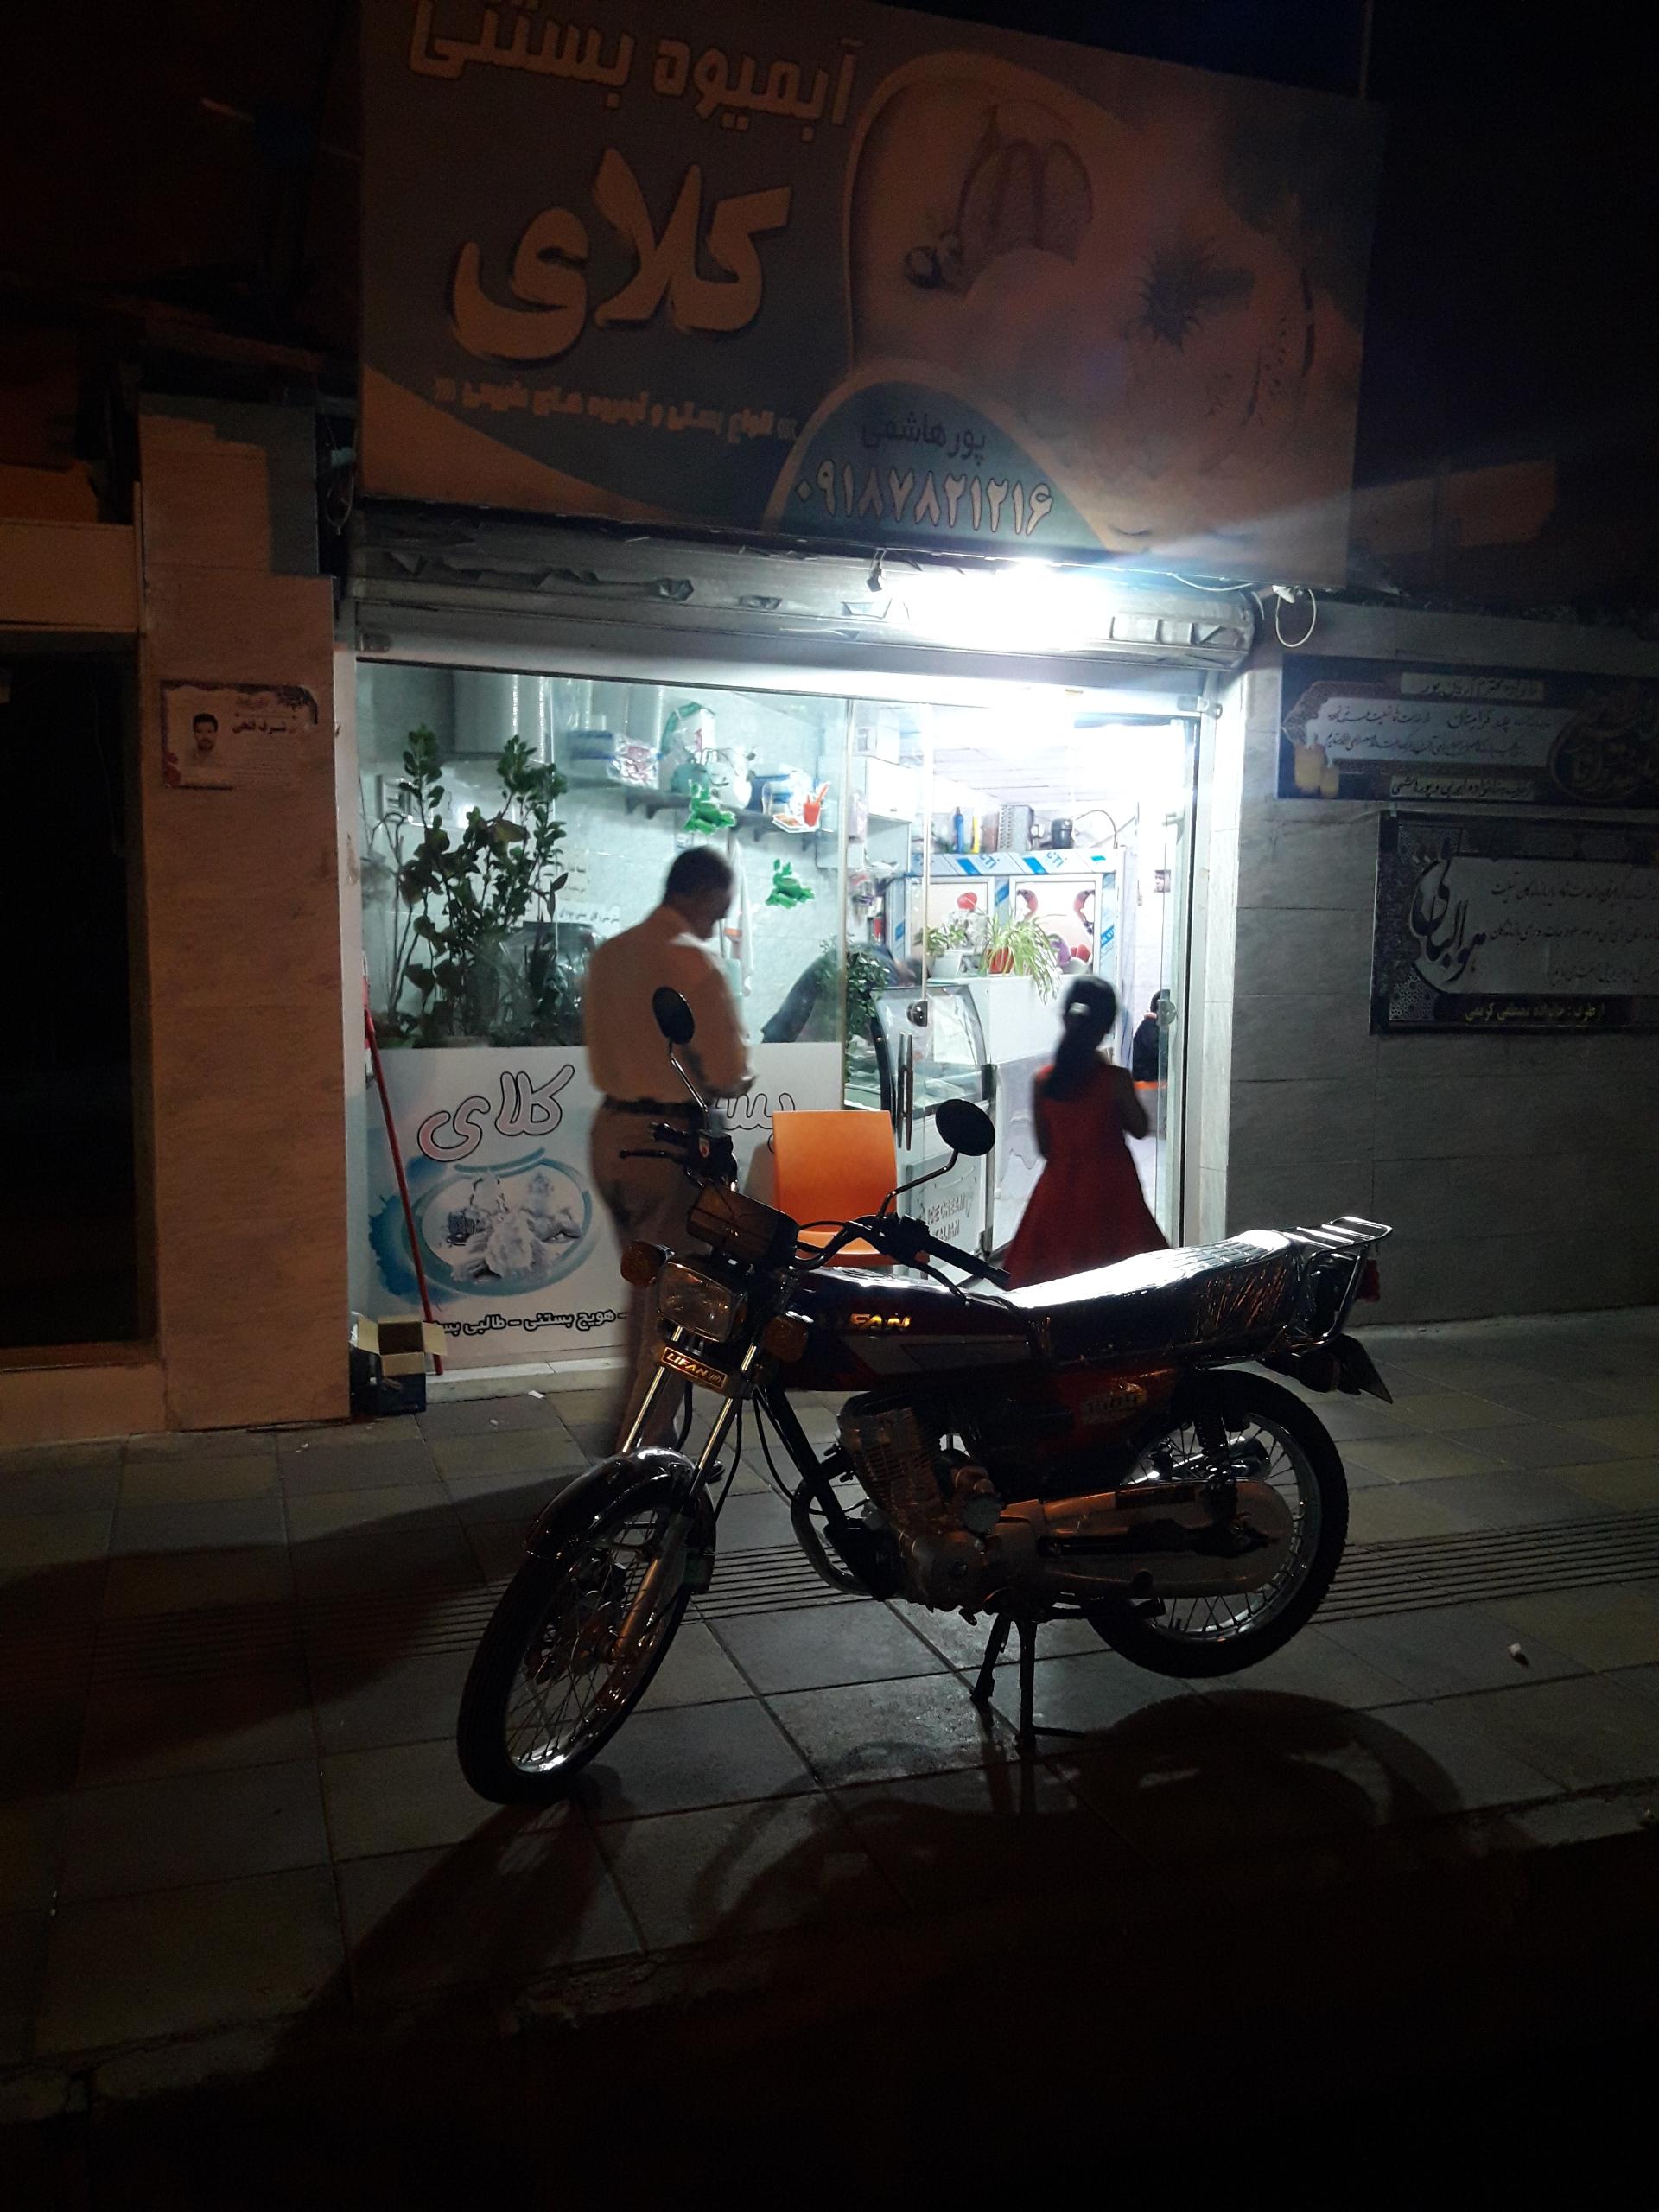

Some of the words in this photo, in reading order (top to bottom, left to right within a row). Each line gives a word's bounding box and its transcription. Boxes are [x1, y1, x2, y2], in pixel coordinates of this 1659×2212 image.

[408, 0, 636, 111] بستنی
[652, 36, 862, 143] آبمیوه
[449, 148, 791, 364] کلای
[795, 458, 1052, 537] ۰۹۱۸۷۸۲۱۲۱۶
[417, 1064, 575, 1163] کلای
[462, 1313, 506, 1336] طالبی
[523, 1312, 574, 1332] بستنی
[666, 1352, 709, 1377] LIFAN
